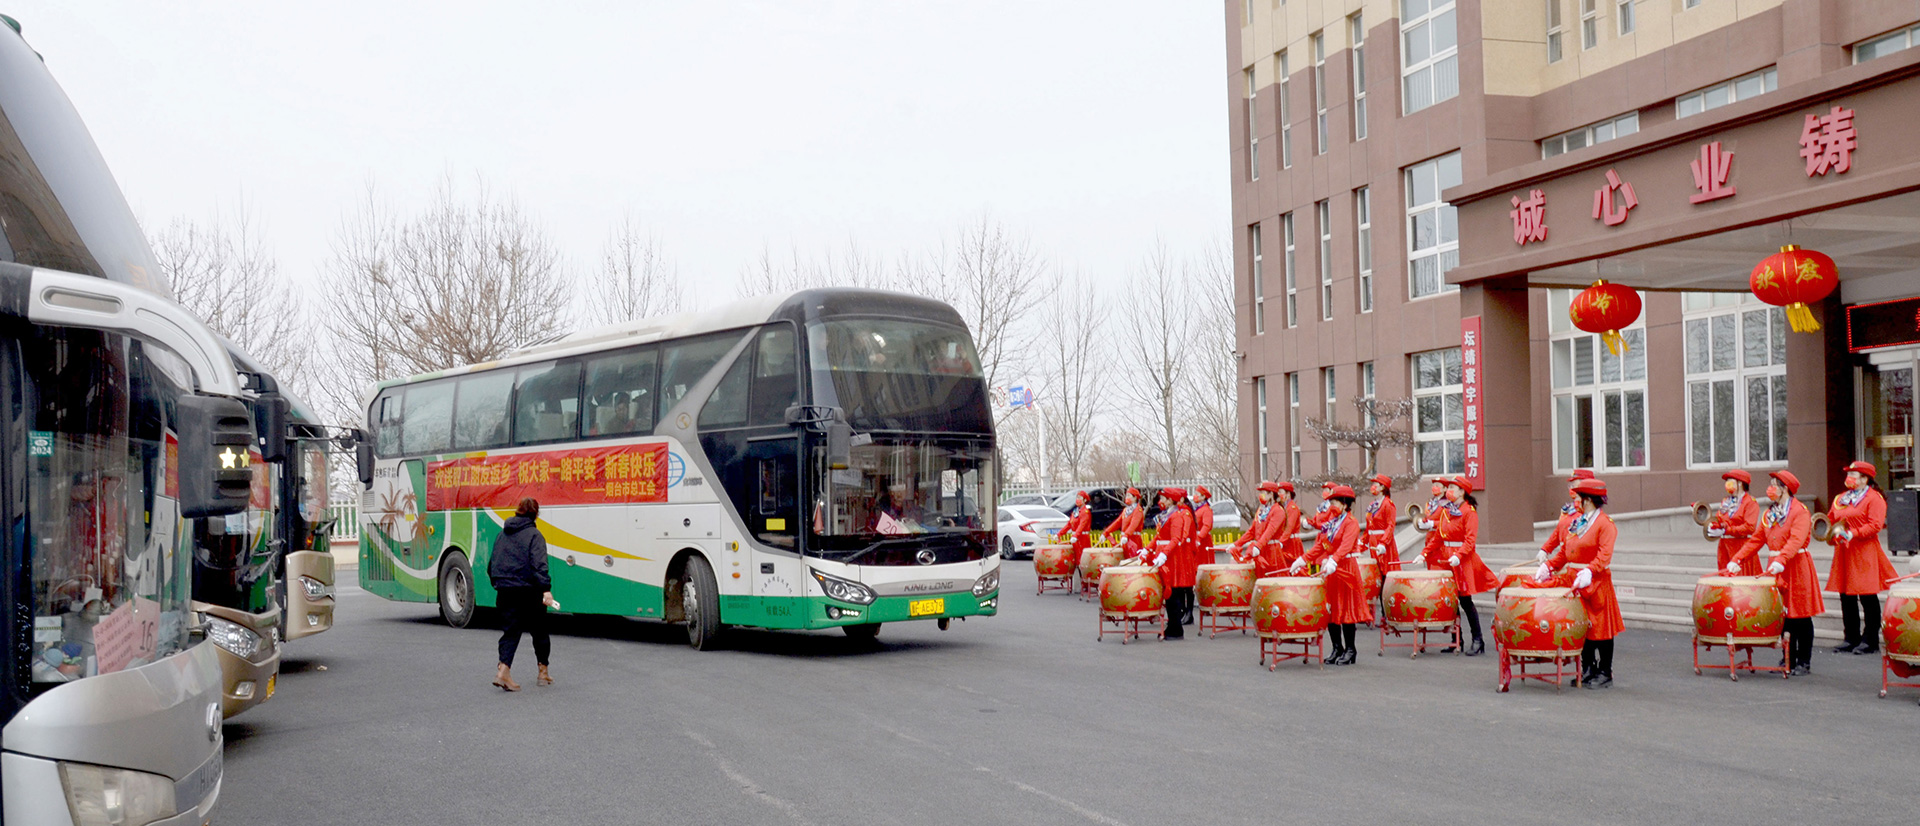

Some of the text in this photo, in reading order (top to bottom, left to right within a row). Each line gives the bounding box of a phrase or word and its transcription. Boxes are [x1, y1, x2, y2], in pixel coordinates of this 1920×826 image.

[31, 446, 52, 455] 2024
[434, 451, 656, 489] 欢送职工朋友返乡 祝大家一路平安 新春快乐
[883, 521, 897, 534] 20
[904, 581, 953, 592] KING LONG
[139, 620, 154, 652] 16
